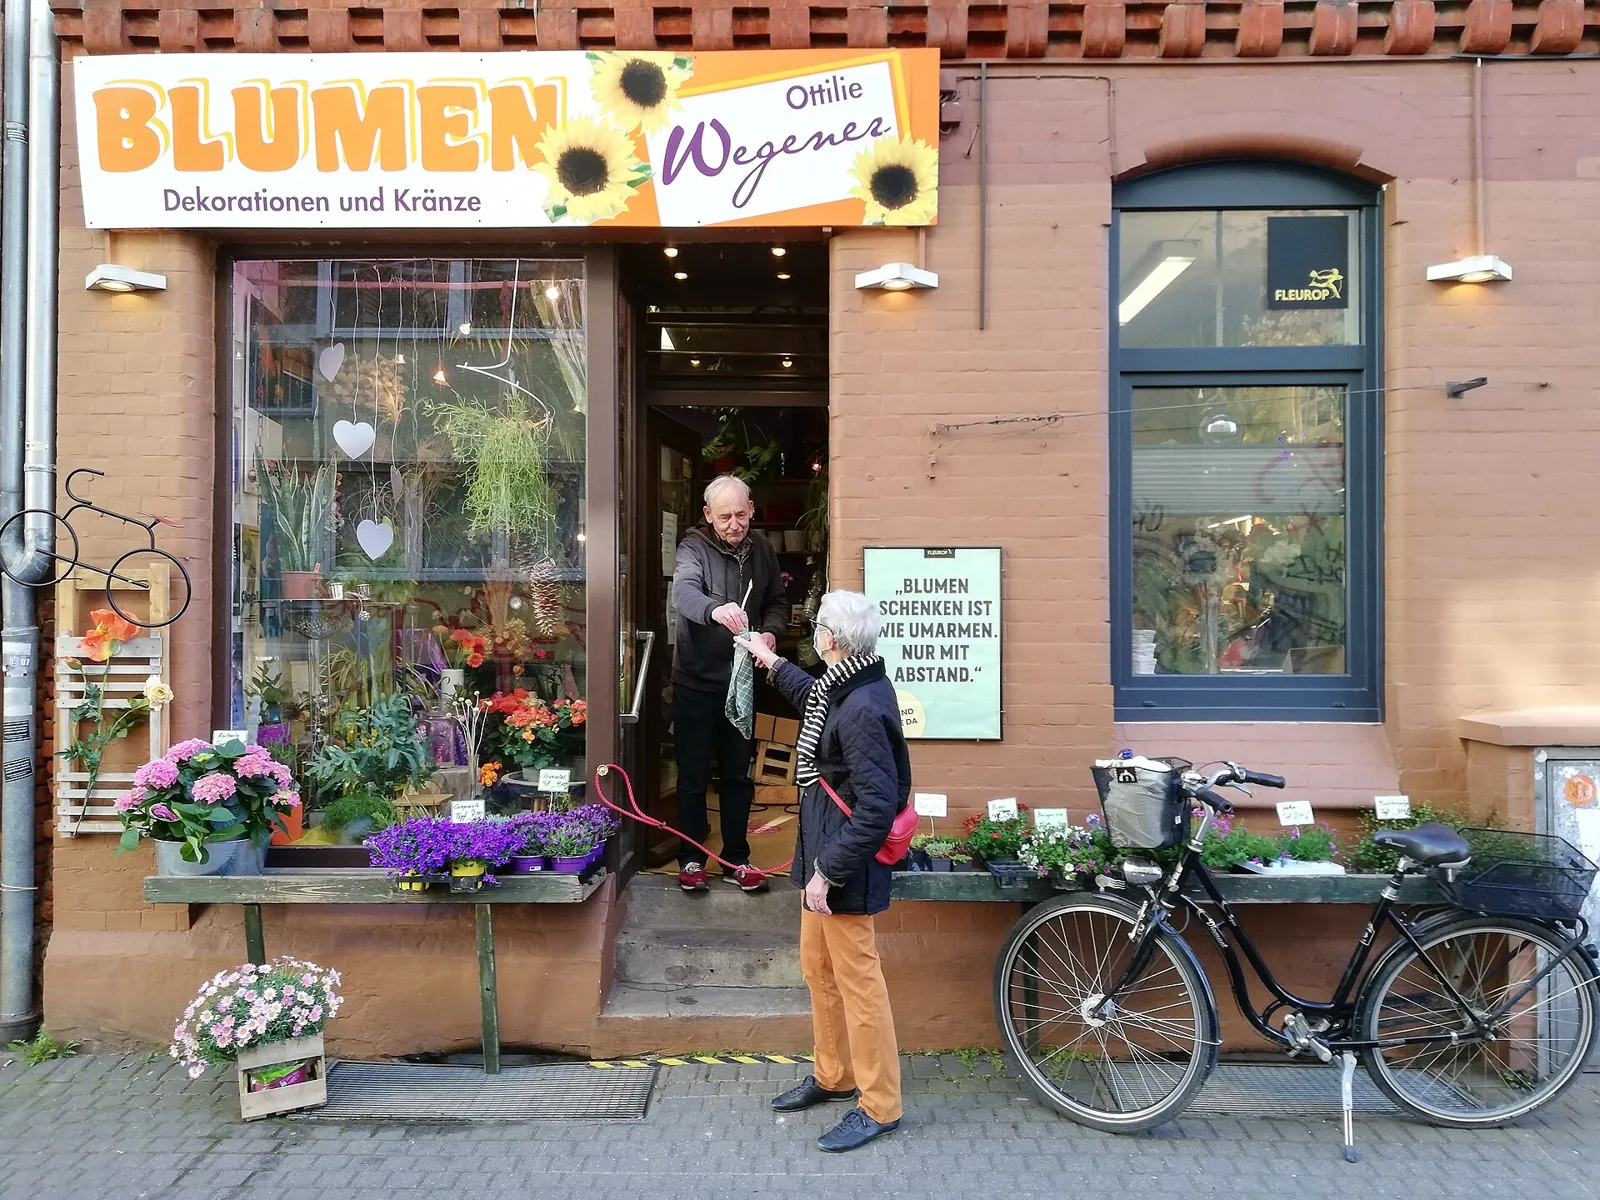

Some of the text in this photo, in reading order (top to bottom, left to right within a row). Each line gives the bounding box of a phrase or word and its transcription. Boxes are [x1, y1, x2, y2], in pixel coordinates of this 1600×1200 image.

[787, 75, 863, 110] Ottilie
[92, 77, 566, 172] BLUMEN
[662, 118, 892, 209] Wegener
[163, 186, 482, 212] Dekorationen und Kränze
[1275, 289, 1330, 301] FLEUROP
[895, 578, 969, 596] „BLUMEN
[879, 600, 993, 616] SCHENKEN IST
[909, 622, 998, 638] UMARMEN.
[902, 644, 969, 660] NUR MIT
[894, 666, 982, 683] ABSTAND.“
[901, 708, 914, 716] ND
[905, 717, 918, 725] DA
